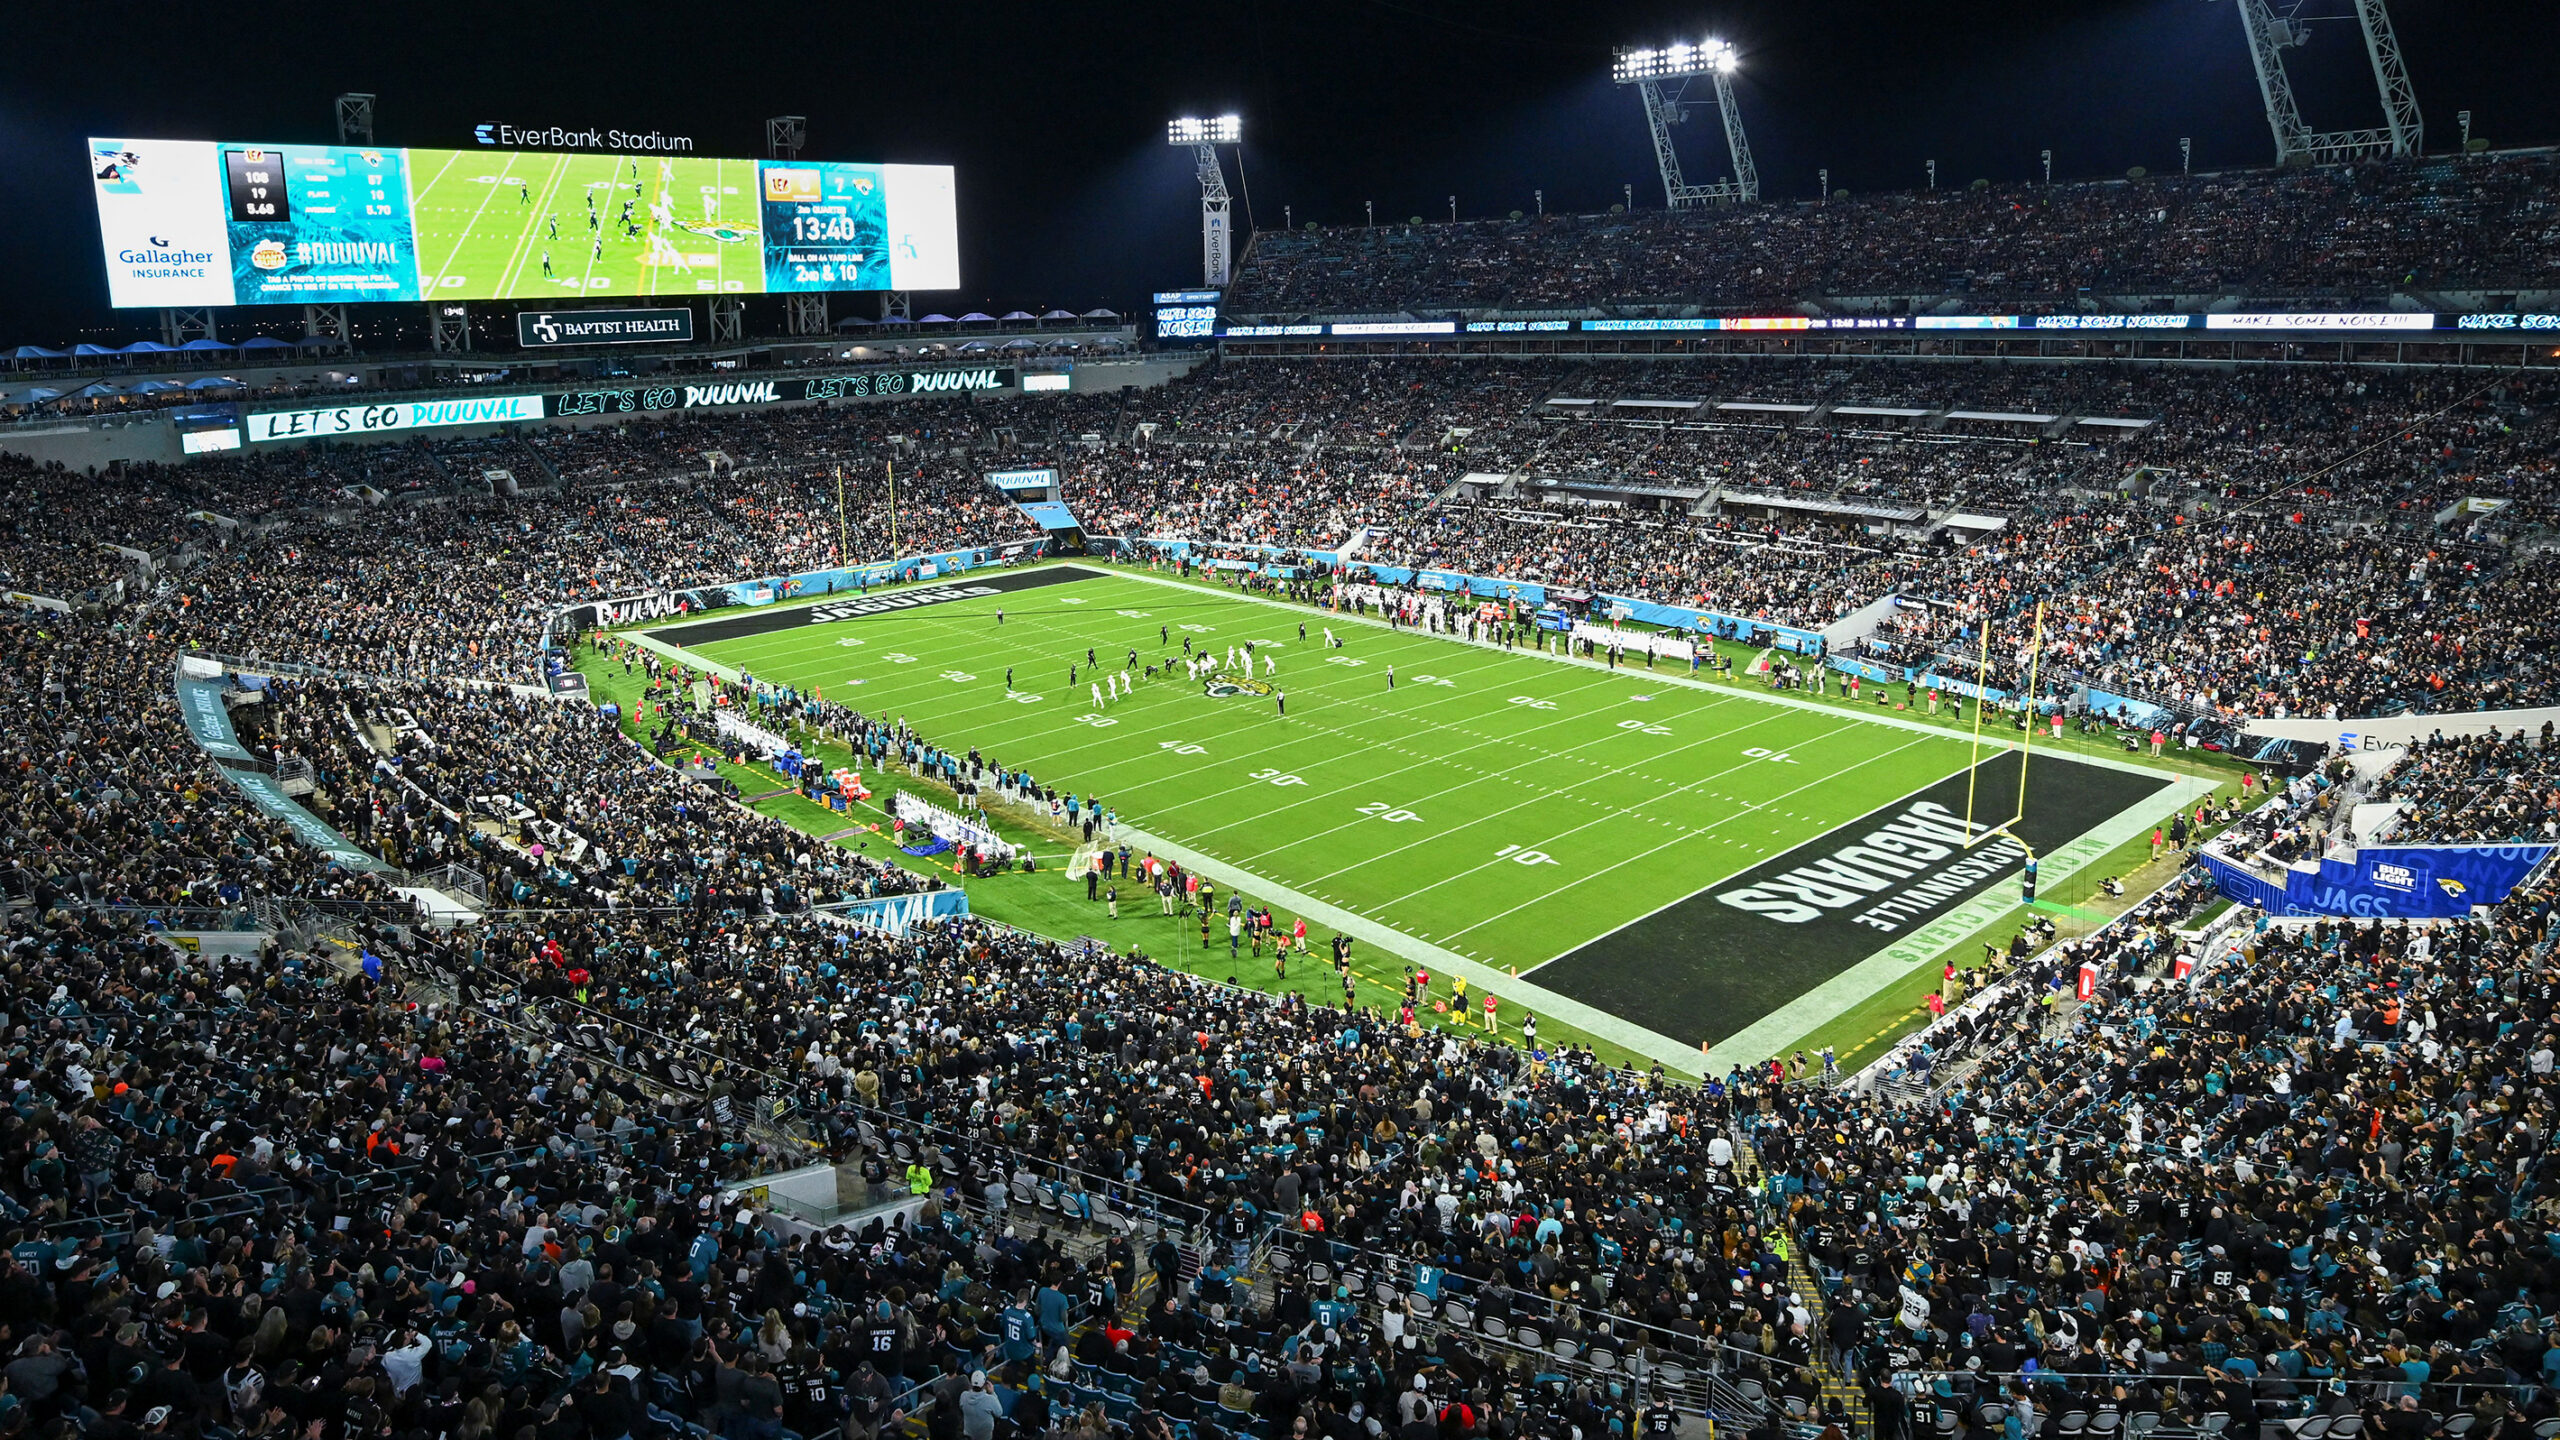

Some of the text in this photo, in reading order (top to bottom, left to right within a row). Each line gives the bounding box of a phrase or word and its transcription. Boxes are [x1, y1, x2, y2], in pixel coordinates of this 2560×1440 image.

[500, 125, 693, 151] EverBank Stadium
[251, 187, 267, 199] 19
[834, 177, 845, 192] 7
[793, 217, 855, 241] 13:40
[119, 249, 213, 270] Gallagher
[296, 242, 400, 265] #DUUUVAL
[1211, 229, 1221, 280] EverBank
[132, 269, 205, 279] INSURANCE
[822, 265, 835, 281] &
[840, 264, 857, 281] 10
[696, 280, 744, 292] 50
[565, 319, 680, 335] BAPTIST HEALTH
[2036, 316, 2078, 328] MAKE
[2080, 315, 2125, 328] SOME
[2232, 315, 2408, 326] MAKE SOME NOISE!!!
[2458, 315, 2517, 328] MAKE
[805, 370, 1003, 400] LET'S GO DUUUVAL
[558, 381, 781, 417] LET'S GO DUUUVAL
[268, 399, 527, 437] LET'S GO DUUUVAL
[811, 586, 956, 612] JACKSONVILLE
[811, 586, 1003, 624] JAGUARS
[1073, 713, 1119, 727] 50
[1158, 740, 1202, 755] 40
[1741, 747, 1791, 763] 10
[1249, 768, 1302, 786] 30
[1355, 802, 1416, 822] 20
[1495, 844, 1549, 866] 10
[1715, 800, 1989, 923] JAGUARS
[2379, 864, 2411, 877] BUD
[1852, 835, 2036, 932] JACKSONVILLE
[2373, 871, 2415, 888] LIGHT
[2314, 887, 2390, 918] JAGS
[1888, 912, 1985, 963] CLEATS
[884, 1237, 897, 1250] 16
[1087, 1288, 1101, 1305] 27
[1320, 1311, 1330, 1326] 0
[1007, 1324, 1019, 1341] 16
[872, 1336, 891, 1352] 16
[810, 1387, 826, 1401] 10
[1653, 1420, 1667, 1431] 16
[1916, 1411, 1931, 1423] 91
[343, 1421, 363, 1439] 27
